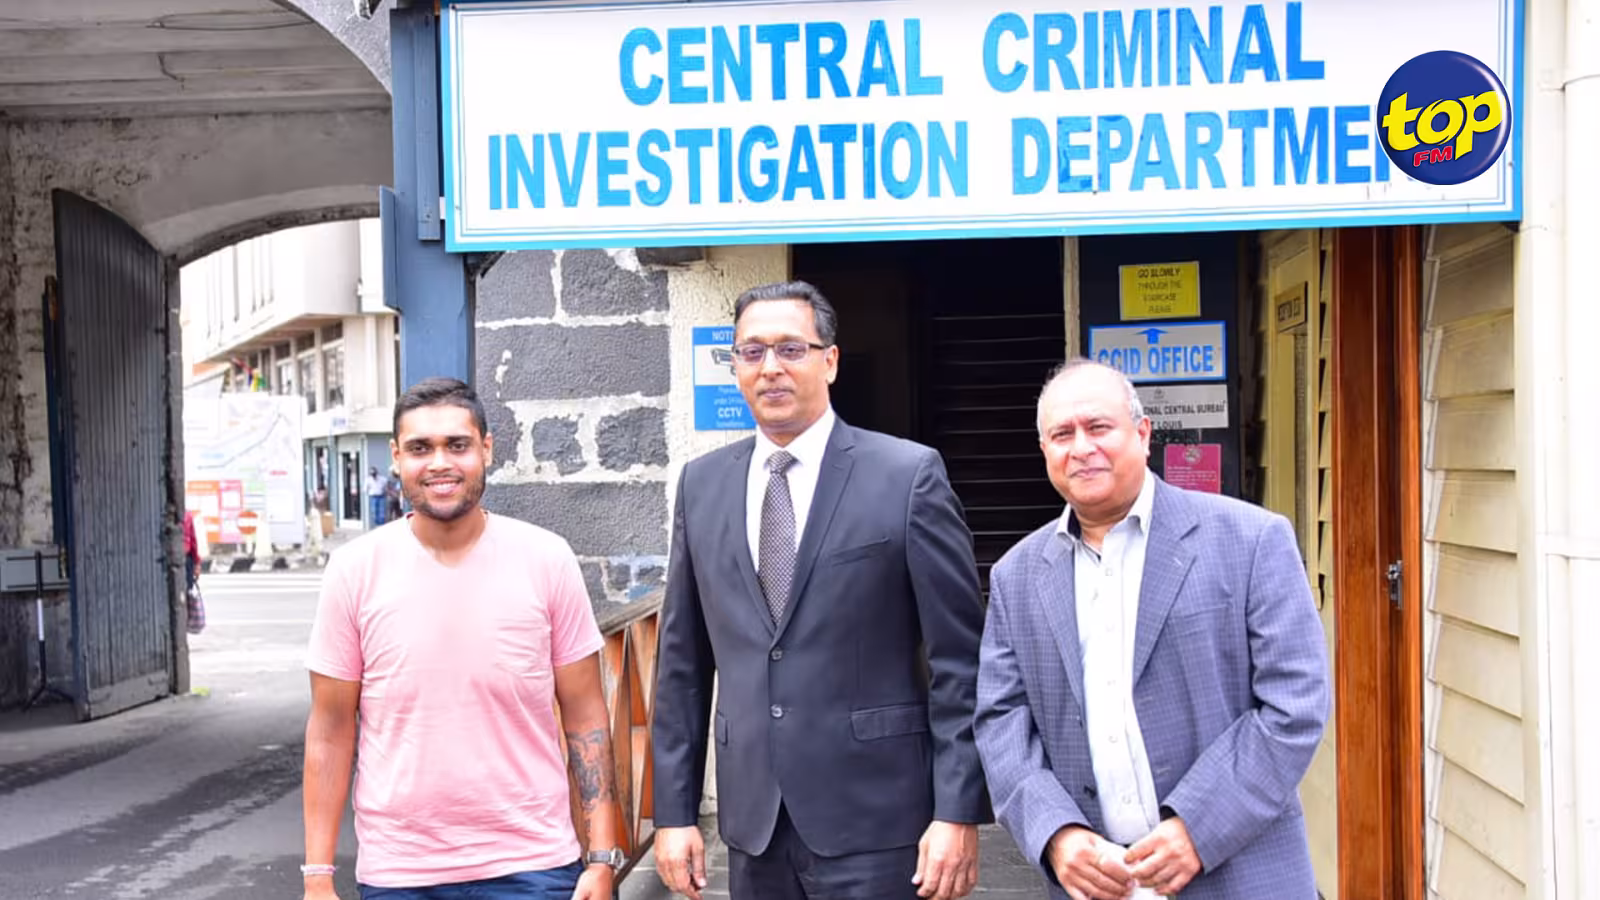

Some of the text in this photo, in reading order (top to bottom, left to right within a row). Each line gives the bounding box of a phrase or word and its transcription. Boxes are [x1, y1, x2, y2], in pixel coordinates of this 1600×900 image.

[620, 1, 1325, 106] CENTRAL CRIMINAL
[488, 105, 1415, 210] INVESTIGATION DEPARTME
[712, 330, 735, 342] NOTI
[1147, 345, 1214, 374] OFFICE
[718, 407, 742, 419] CCTV
[1143, 402, 1225, 416] ONAL CENTRAL BUREAU
[1156, 420, 1182, 430] LOUIS
